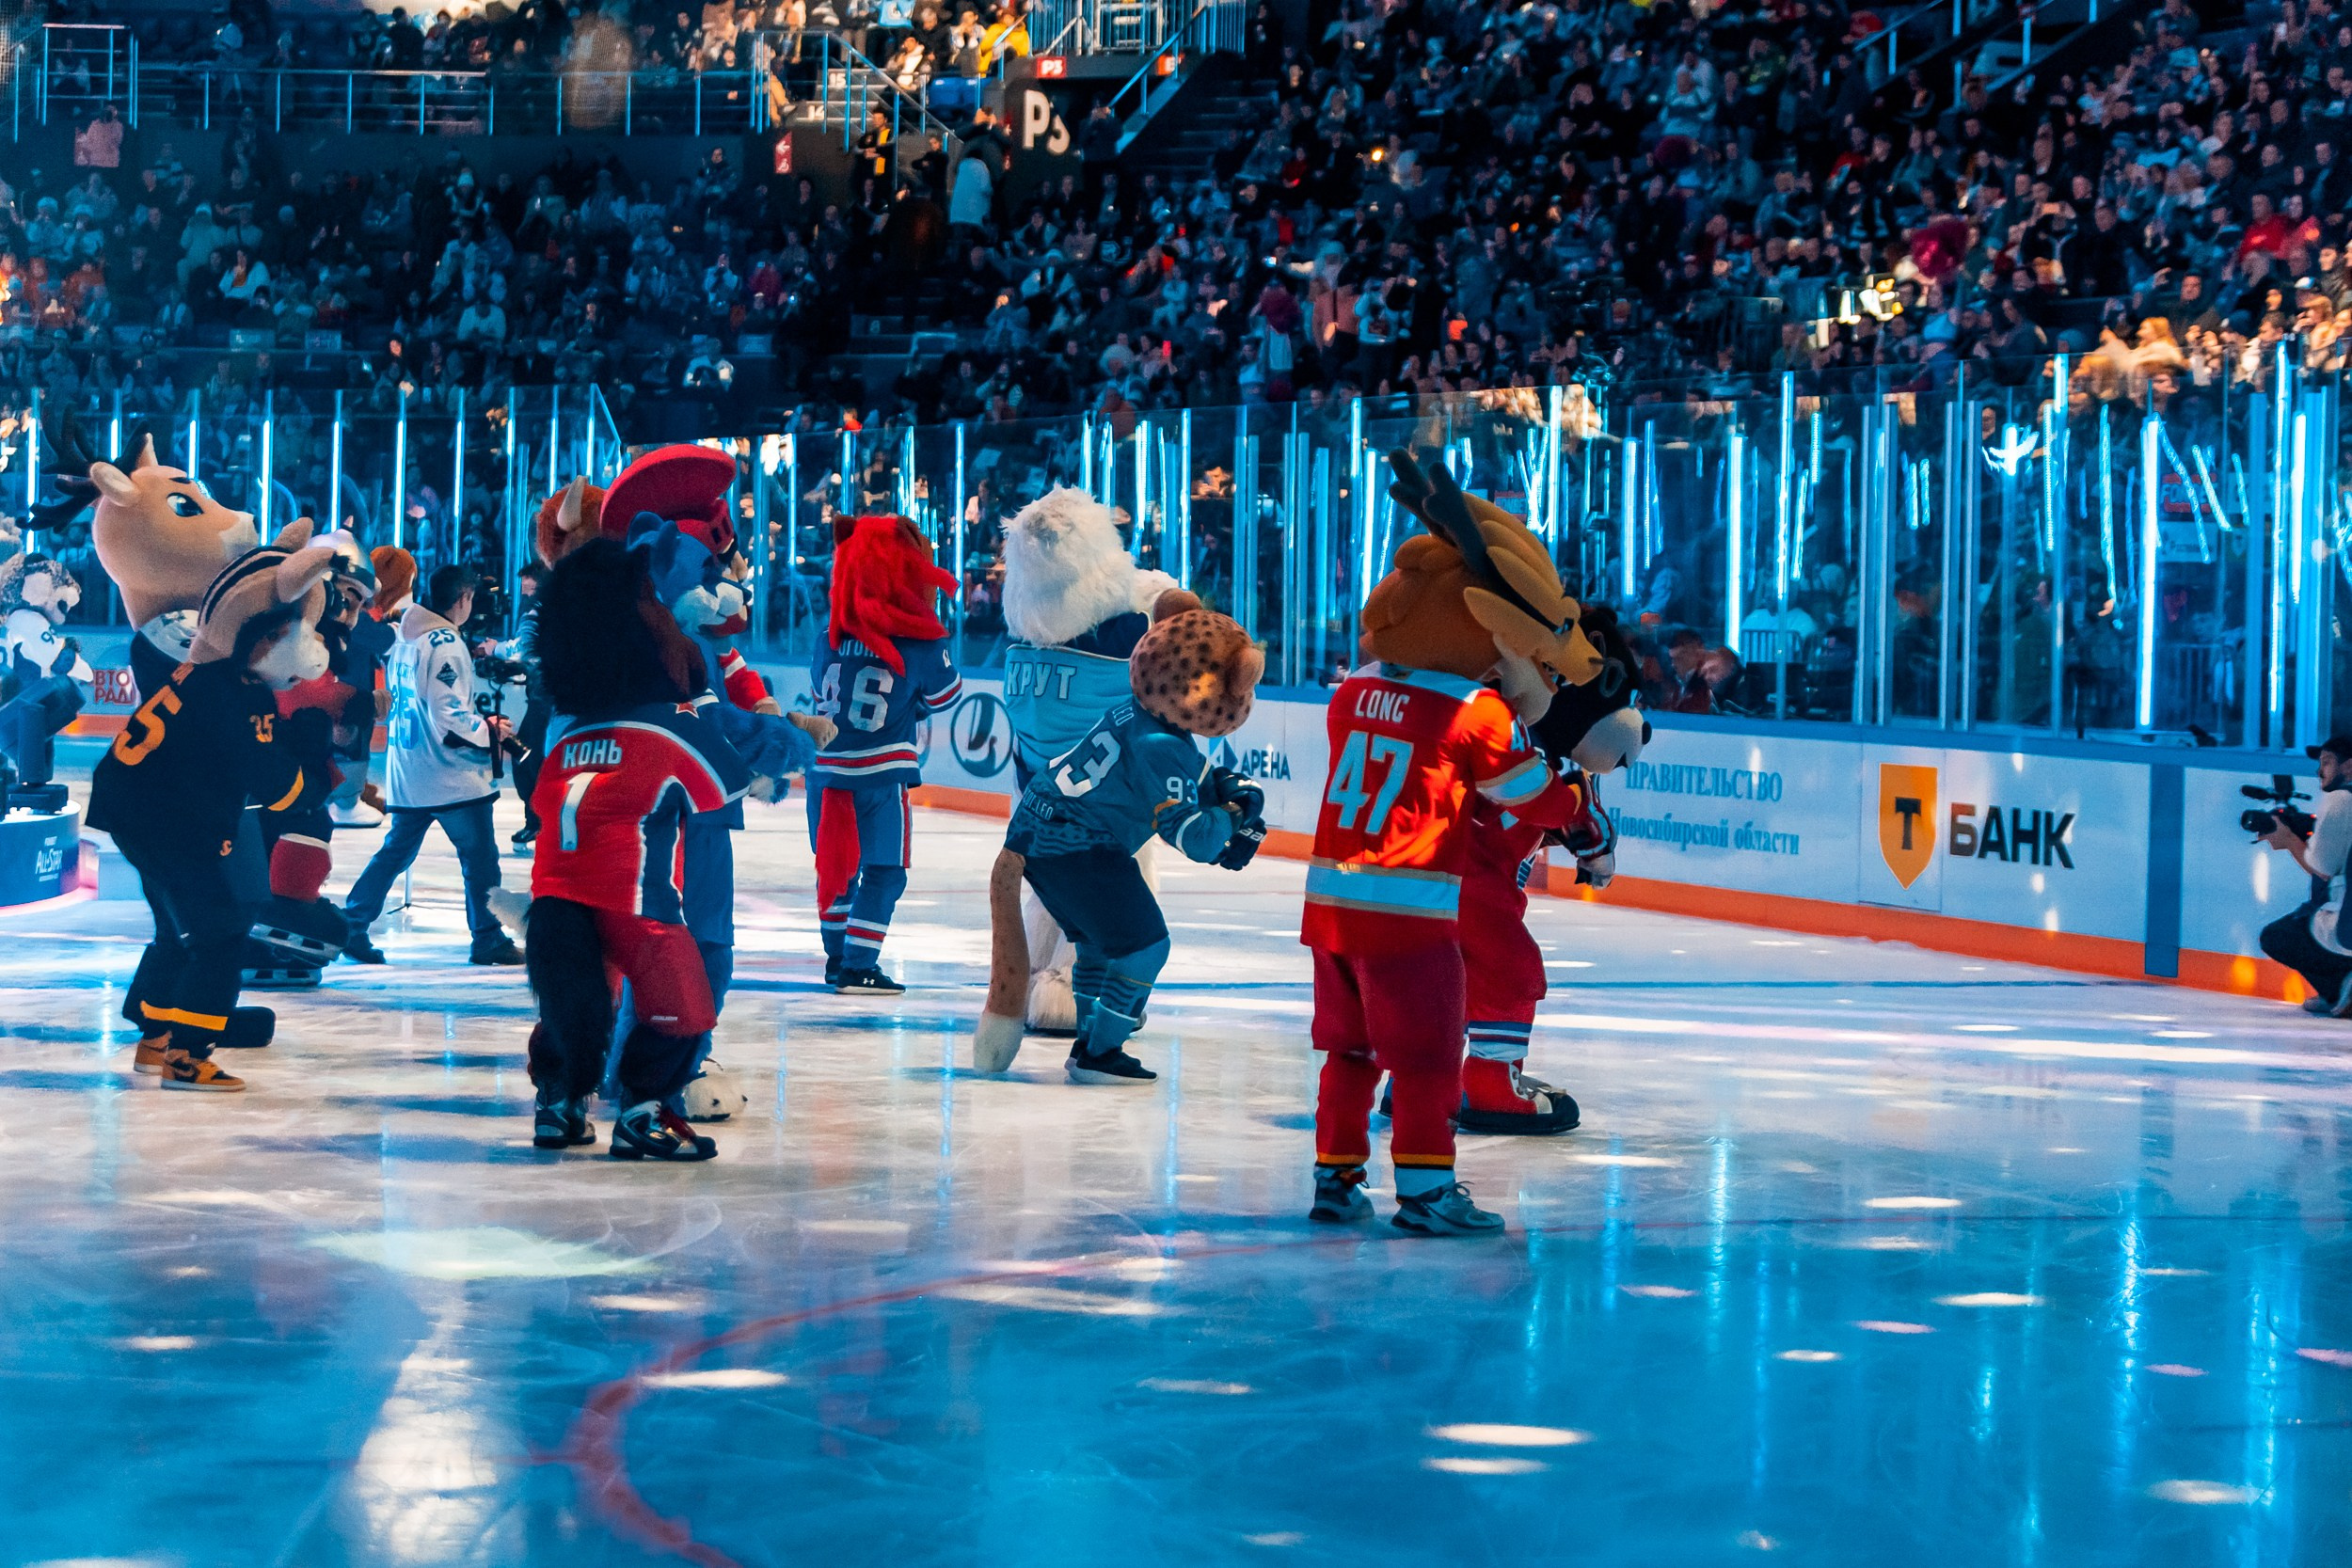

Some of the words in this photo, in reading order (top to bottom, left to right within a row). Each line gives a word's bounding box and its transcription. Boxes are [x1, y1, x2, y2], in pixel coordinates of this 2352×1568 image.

[428, 628, 456, 648] 25
[83, 669, 130, 688] ВТО
[817, 662, 894, 732] 46
[1007, 661, 1078, 701] КРУТ
[562, 738, 623, 769] КОНЬ
[1241, 749, 1292, 781] АРЕНА
[1167, 776, 1200, 805] 93
[1327, 729, 1414, 835] 47
[1625, 761, 1784, 802] ПРАВИТЕЛЬСТВО
[560, 771, 599, 851] 1
[1608, 807, 1729, 852] Новосибирской
[1733, 820, 1801, 855] области
[1949, 802, 2076, 870] БАНК
